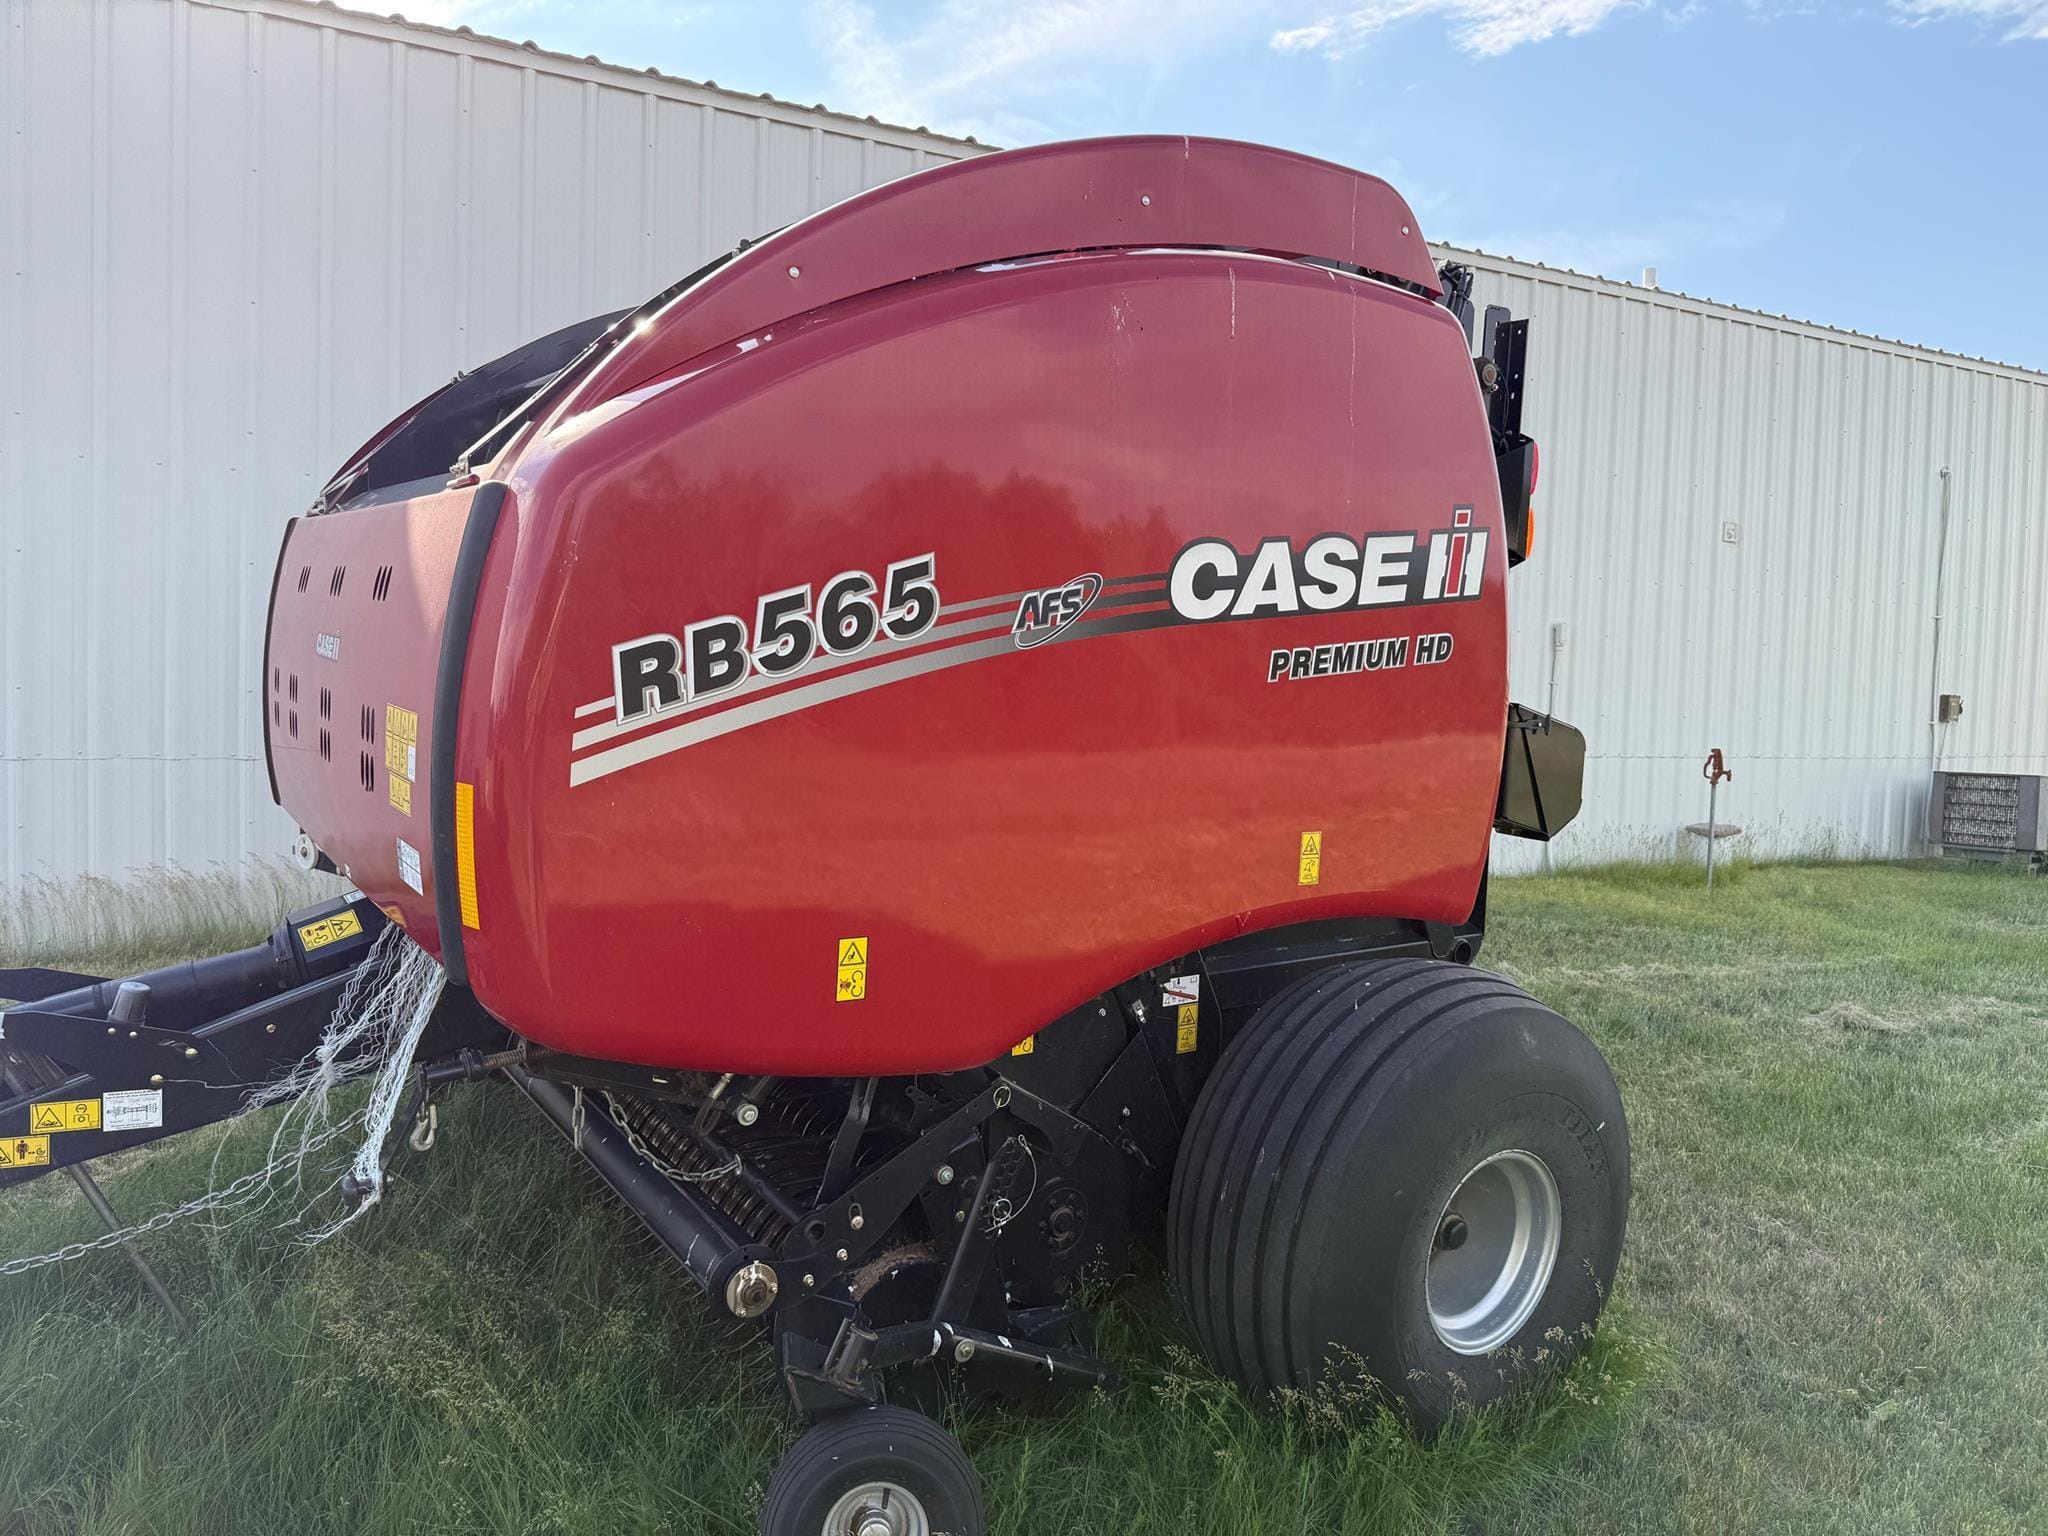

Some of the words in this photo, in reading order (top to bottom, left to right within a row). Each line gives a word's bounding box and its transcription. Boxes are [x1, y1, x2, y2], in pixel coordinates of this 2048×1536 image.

[1011, 584, 1085, 634] AFS
[1171, 535, 1416, 620] CASE
[612, 552, 939, 725] RB565
[1267, 637, 1408, 683] PREMIUM
[1415, 632, 1454, 665] HD
[1559, 1105, 1608, 1179] TITAN
